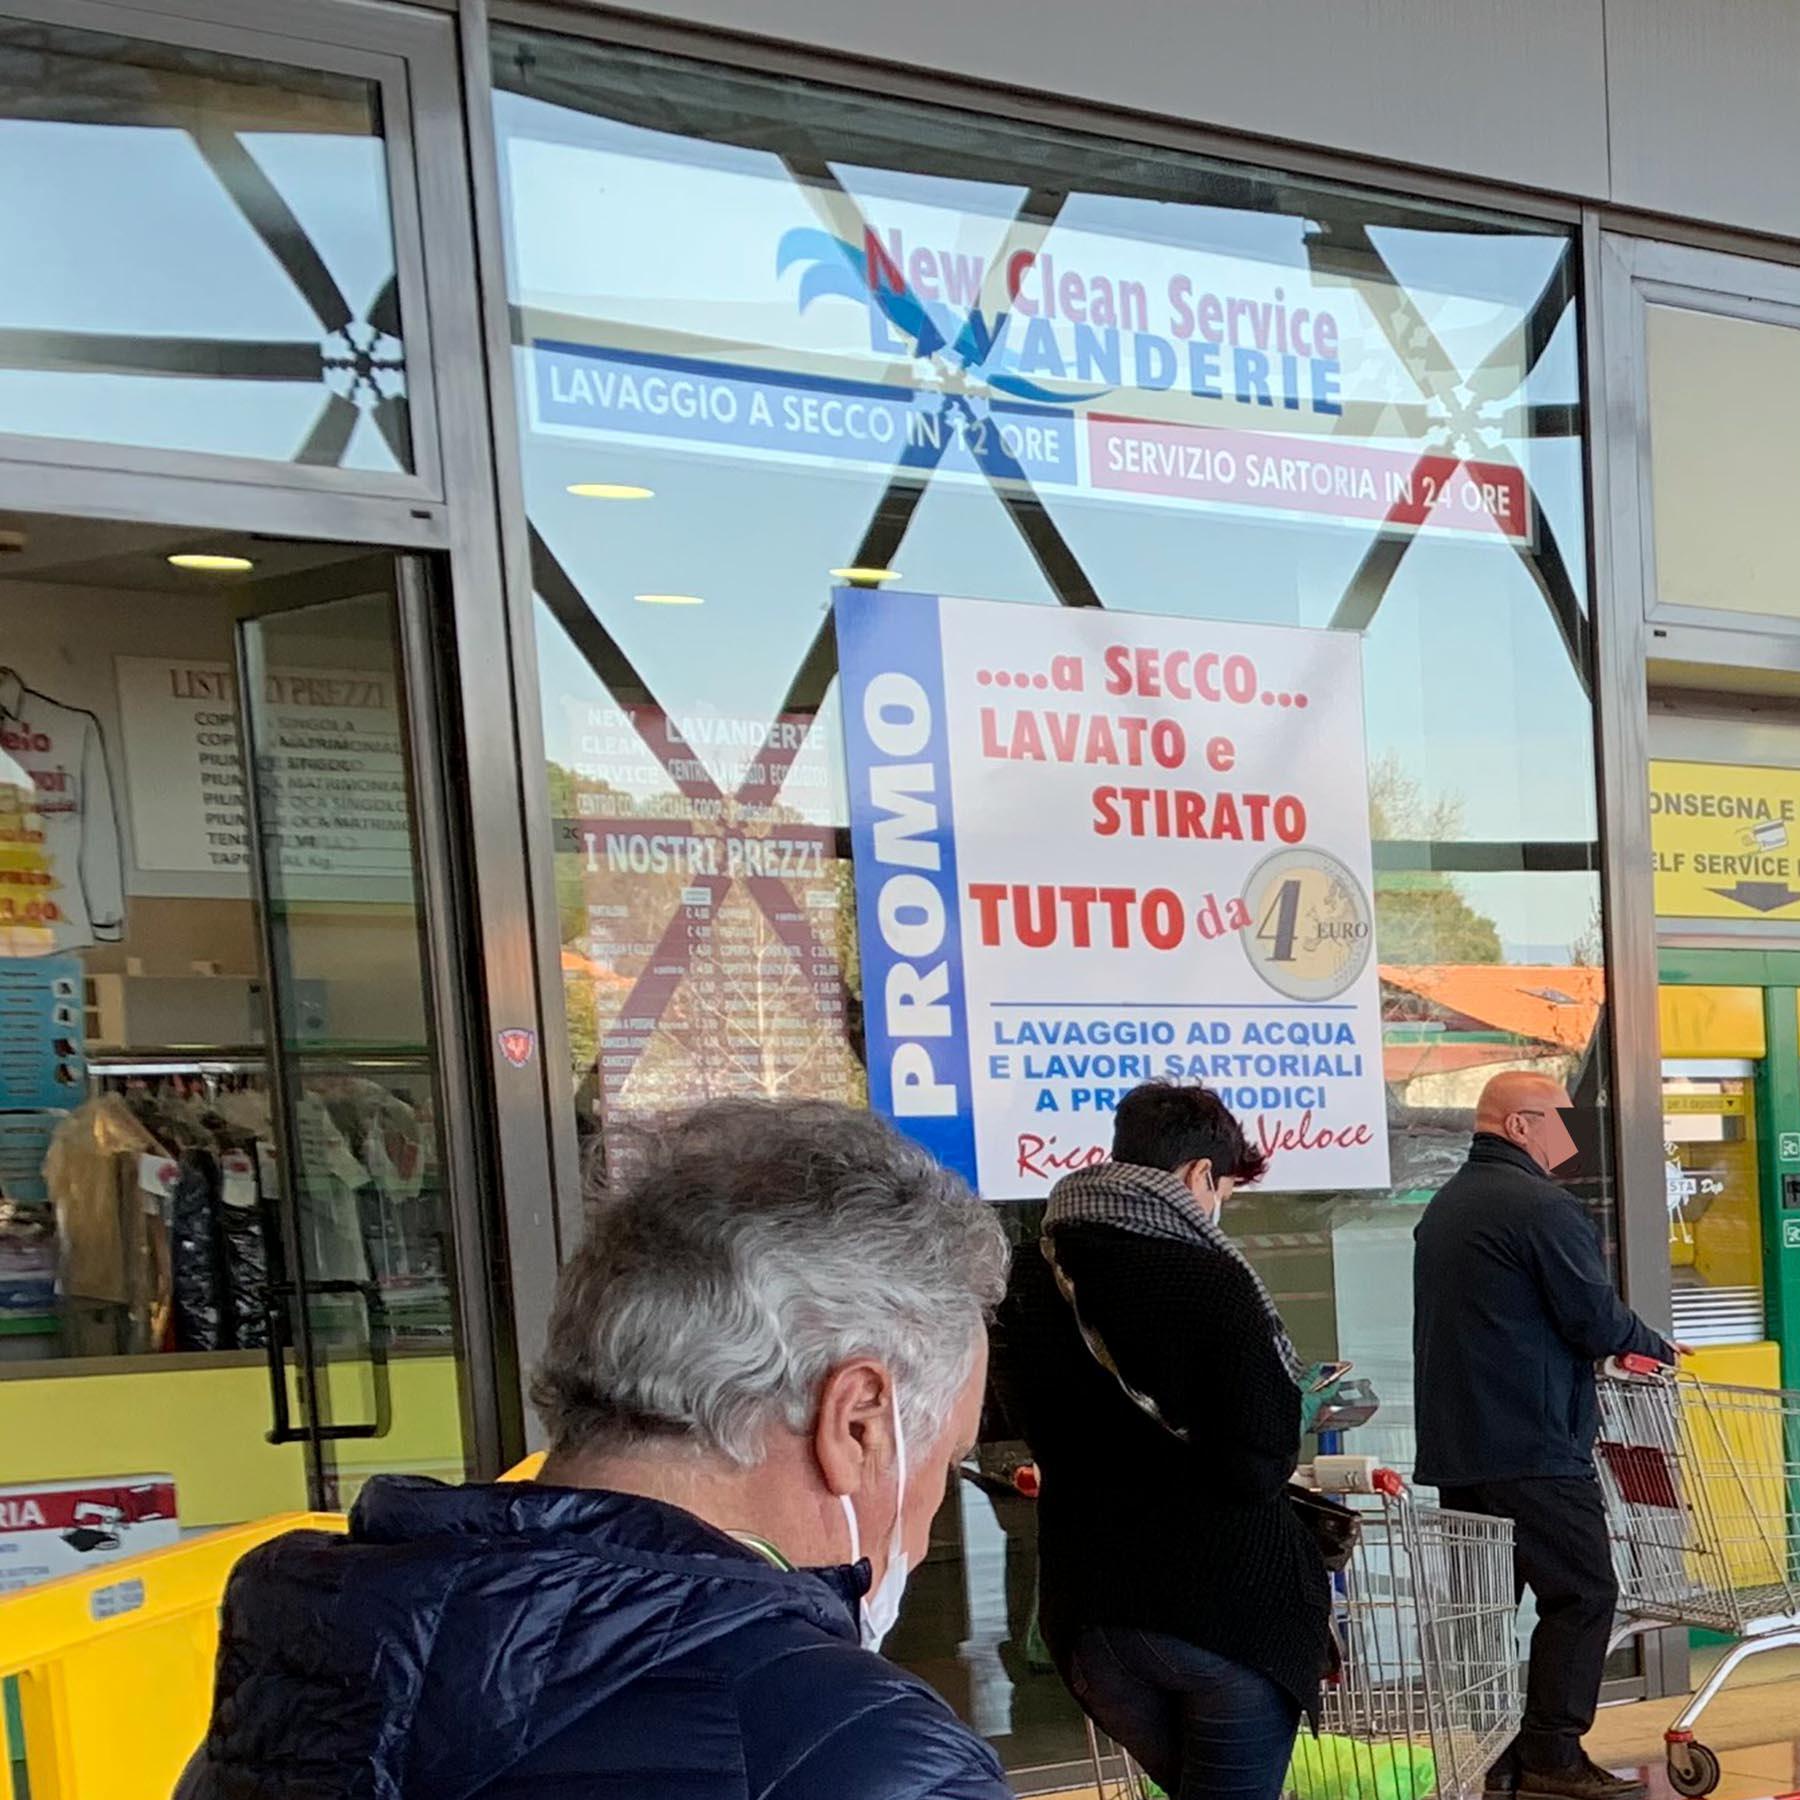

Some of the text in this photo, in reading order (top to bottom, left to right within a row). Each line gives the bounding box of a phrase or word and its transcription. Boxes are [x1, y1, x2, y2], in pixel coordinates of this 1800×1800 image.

[864, 225, 1338, 359] New Clean Service
[870, 300, 1342, 416] LAVANDERIE
[550, 366, 1060, 464] LAVAGGIO A SECCO IN 12 ORE
[1107, 437, 1511, 518] SERVIZIO SARTORIA IN 24 ORE
[1104, 645, 1308, 708] SECCO...
[665, 718, 825, 750] LAVANDERIE
[980, 707, 1236, 771] LAVATO e
[574, 763, 660, 785] SERVICE
[1091, 785, 1307, 844] STIRATO
[1650, 792, 1772, 821] ONSEGNA
[1780, 800, 1795, 822] E
[584, 833, 599, 872] I
[606, 834, 718, 875] NOSTRI
[727, 839, 824, 878] PREZZI
[1651, 851, 1686, 873] ELF
[1694, 854, 1790, 876] SERVICE
[863, 672, 958, 1118] PROMO
[969, 879, 1302, 962] TUTTO da 4
[1318, 921, 1368, 940] EURO
[994, 1020, 1355, 1047] LAVAGGIO AD ACQUA
[989, 1053, 1363, 1079] E LAVORI SARTORIALI
[1035, 1088, 1059, 1112] A
[1257, 1110, 1374, 1156] Veloce
